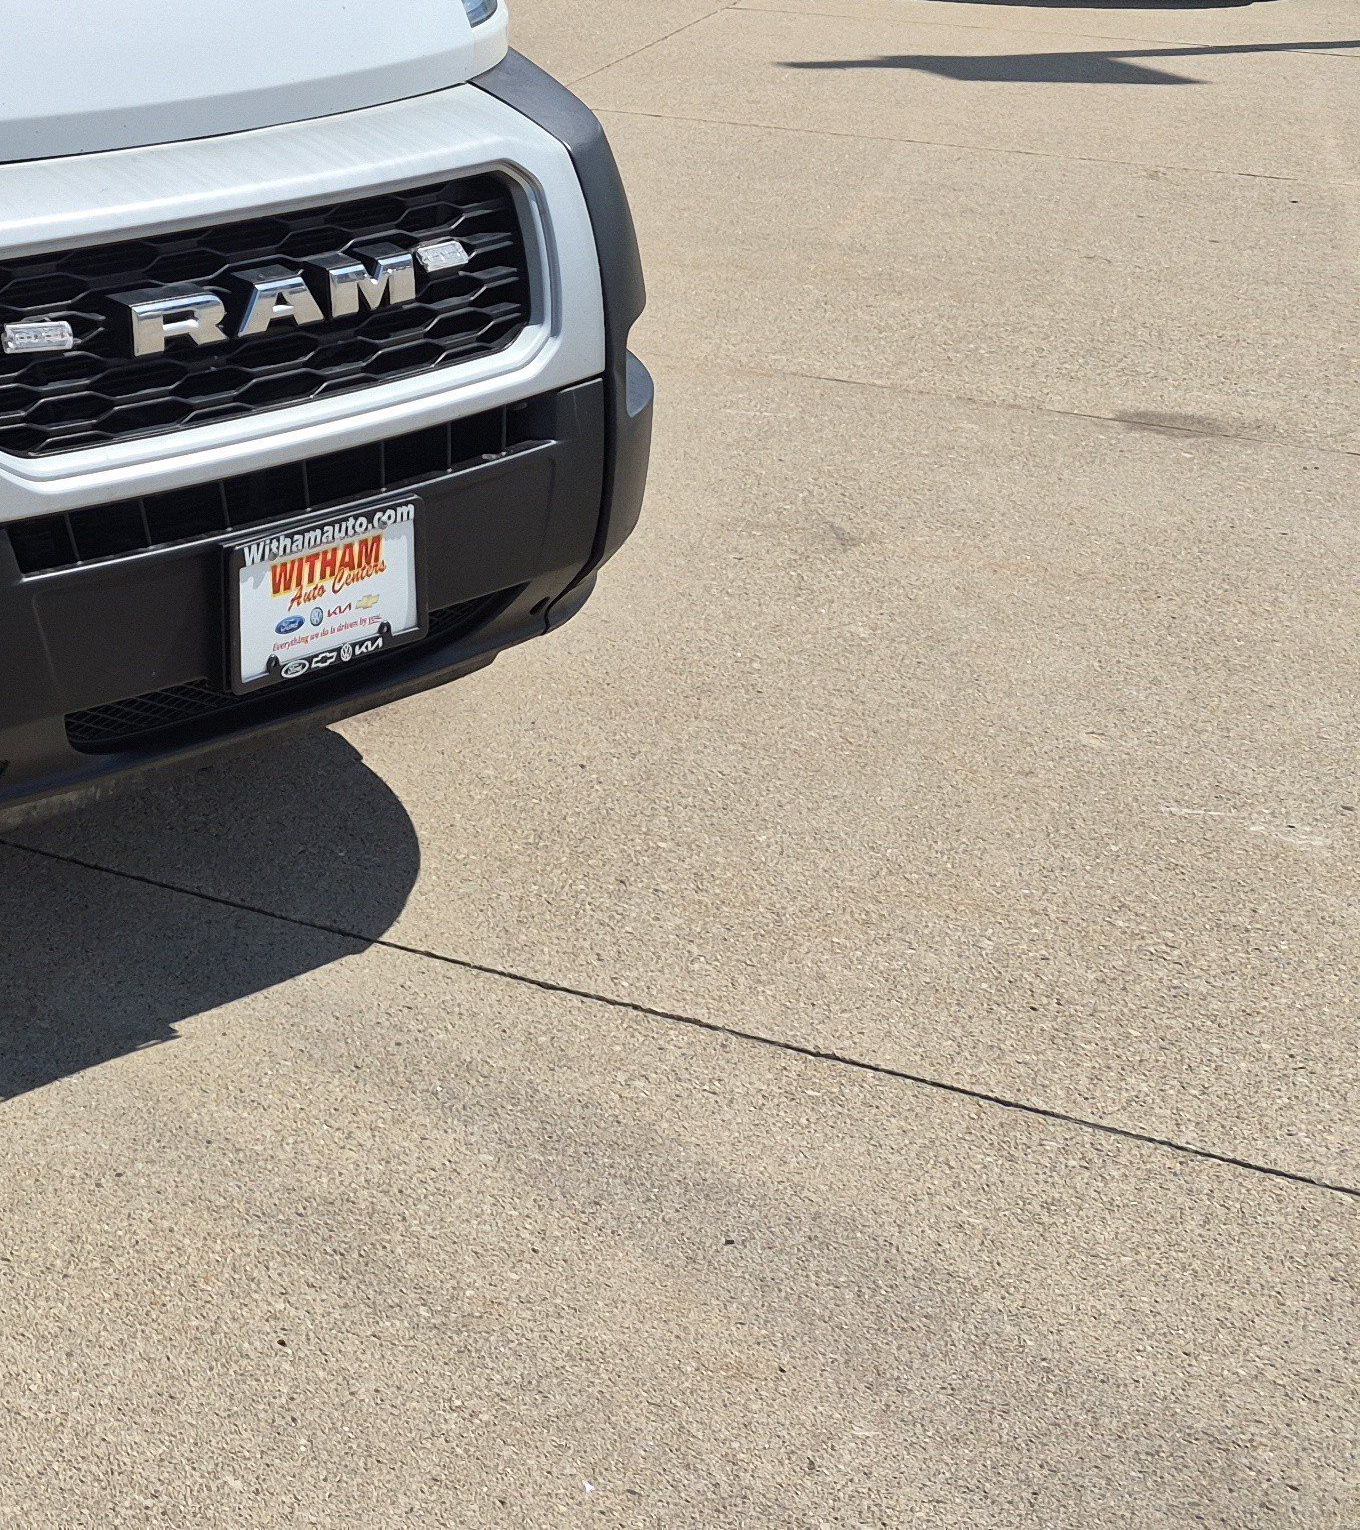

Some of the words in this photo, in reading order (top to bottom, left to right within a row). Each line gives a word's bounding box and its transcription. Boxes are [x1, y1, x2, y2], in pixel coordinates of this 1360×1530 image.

[126, 250, 418, 358] RAM
[243, 503, 415, 567] Withamauto.com
[271, 534, 384, 595] WITHAM
[287, 582, 326, 611] Auto
[332, 558, 387, 594] Centers
